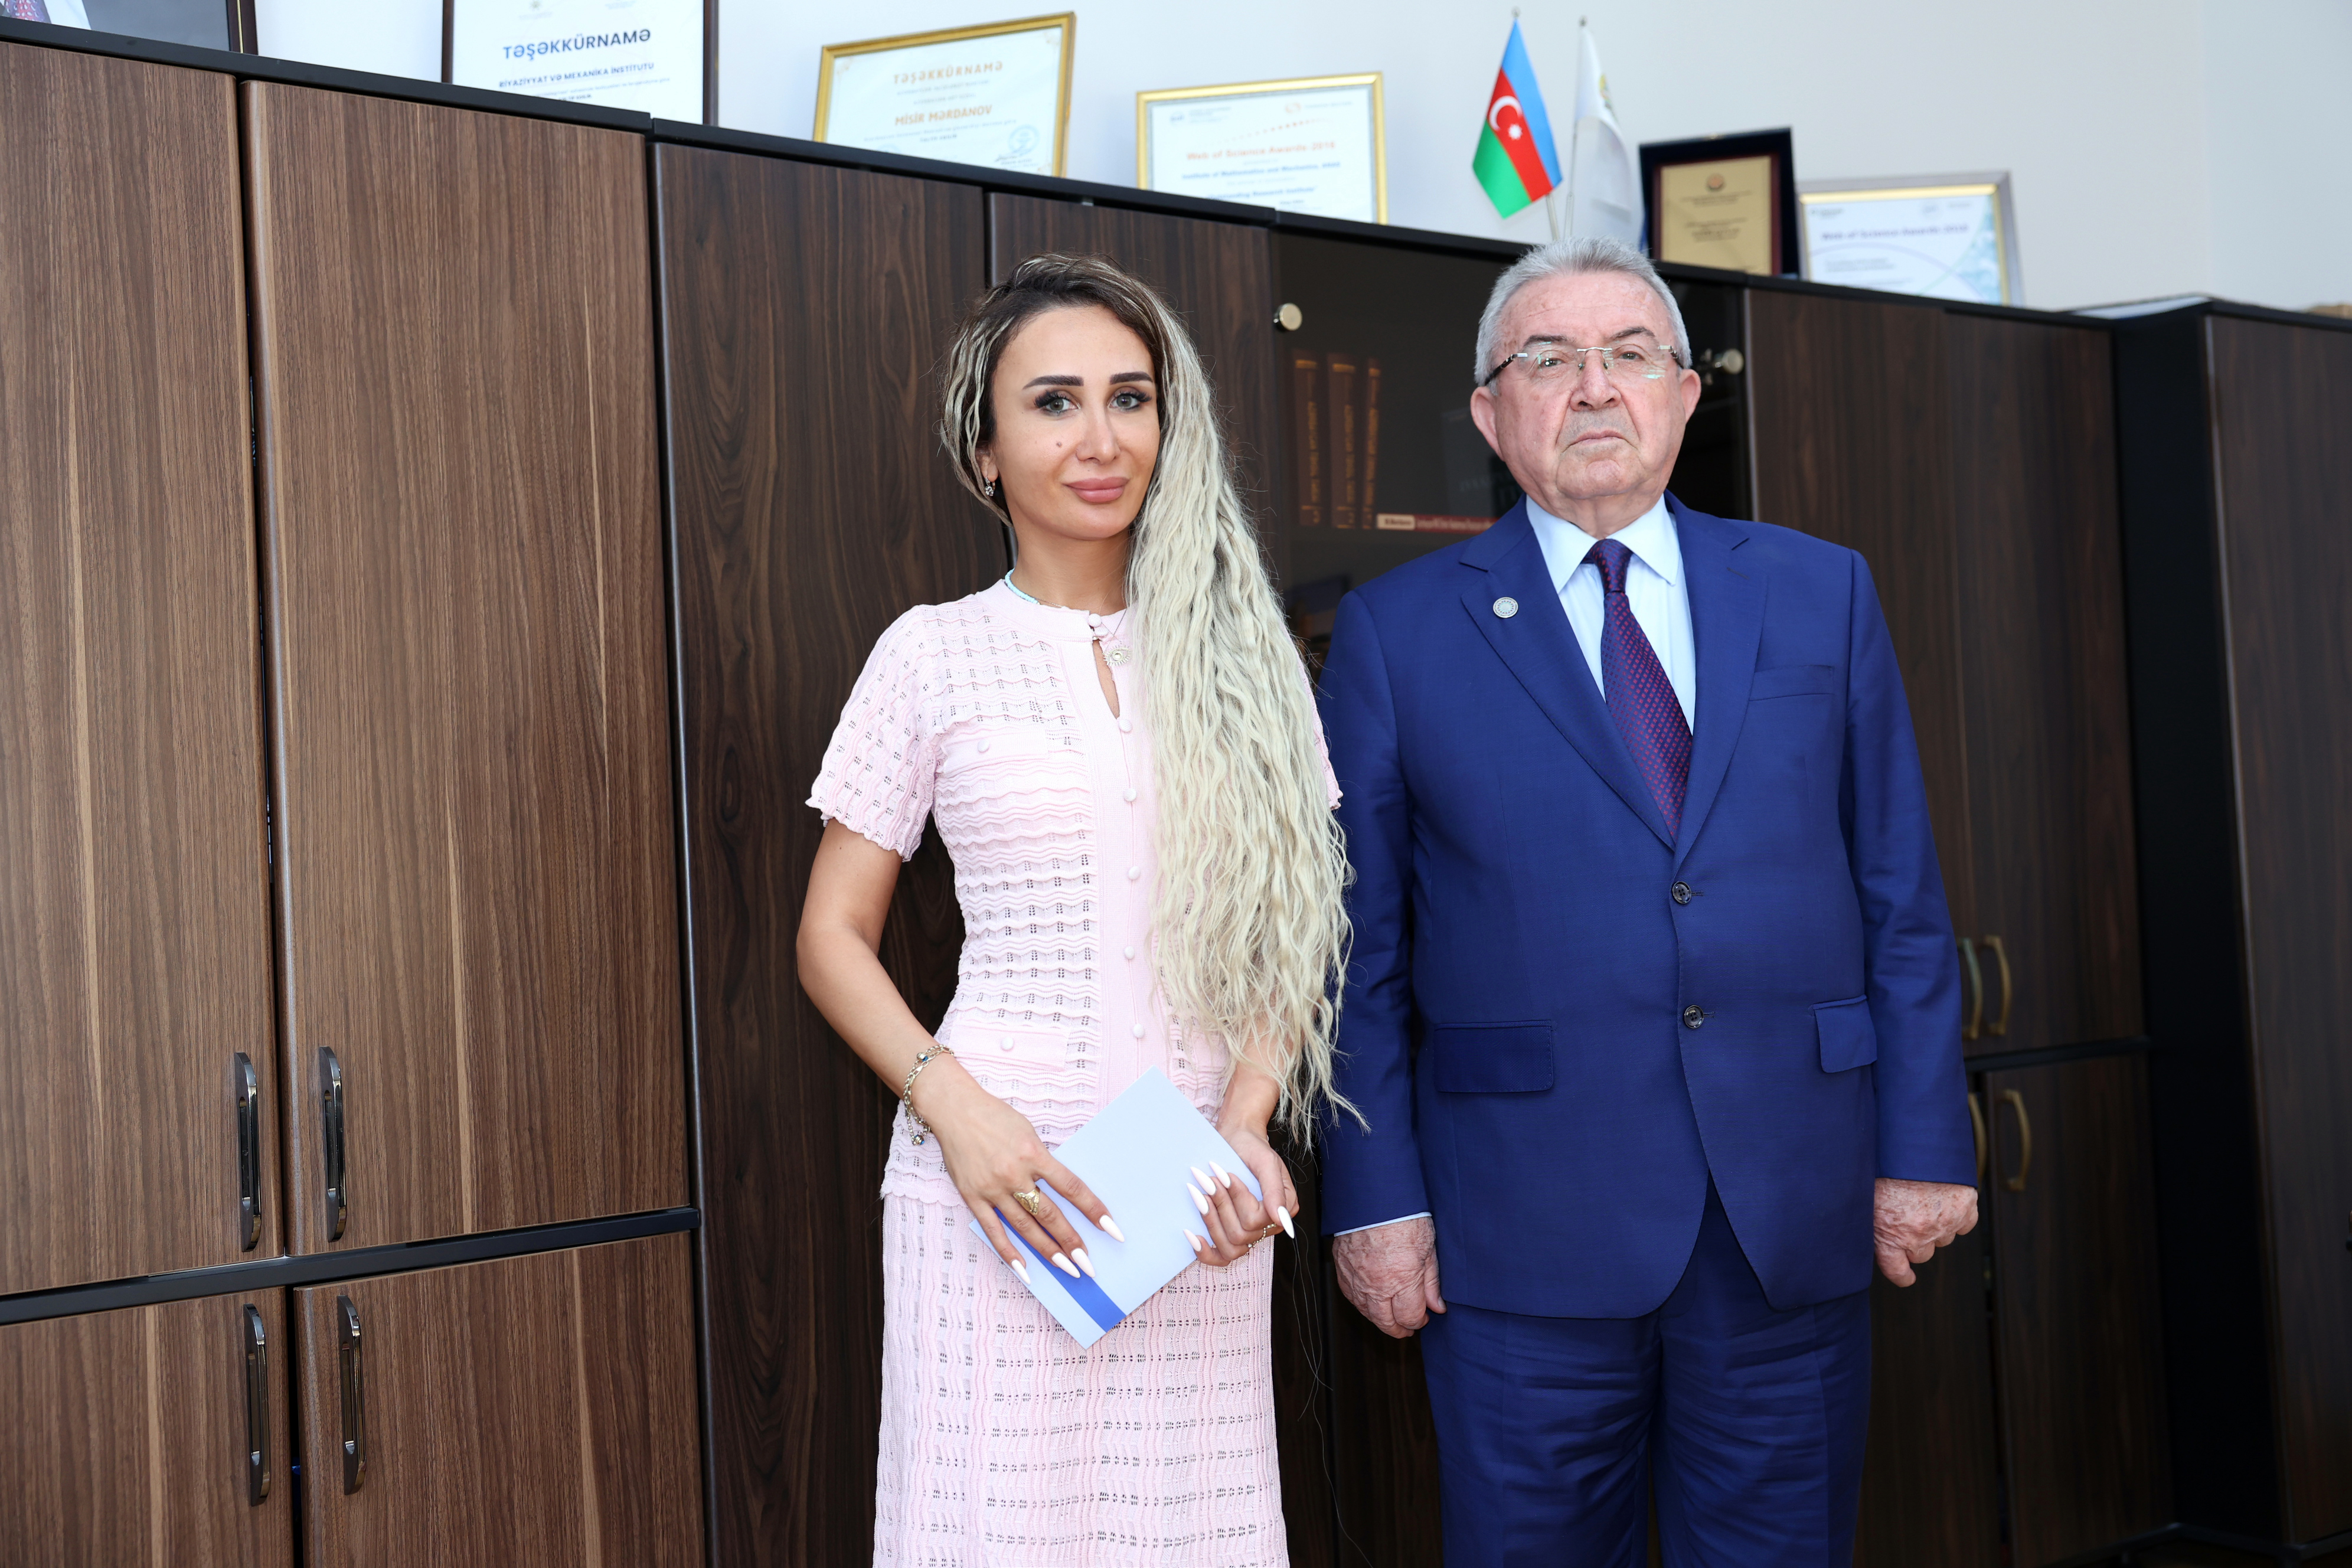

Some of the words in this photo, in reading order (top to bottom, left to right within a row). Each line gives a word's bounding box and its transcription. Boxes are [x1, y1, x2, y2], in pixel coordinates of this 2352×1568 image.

[503, 28, 651, 61] TƏŞƏKKÜRNAMƏ
[610, 61, 655, 75] İNSTİTUTU
[893, 60, 1003, 84] TƏŞƏKKÜRNAMƏ
[894, 112, 925, 126] MİSİR
[929, 104, 993, 122] MƏRDANOV
